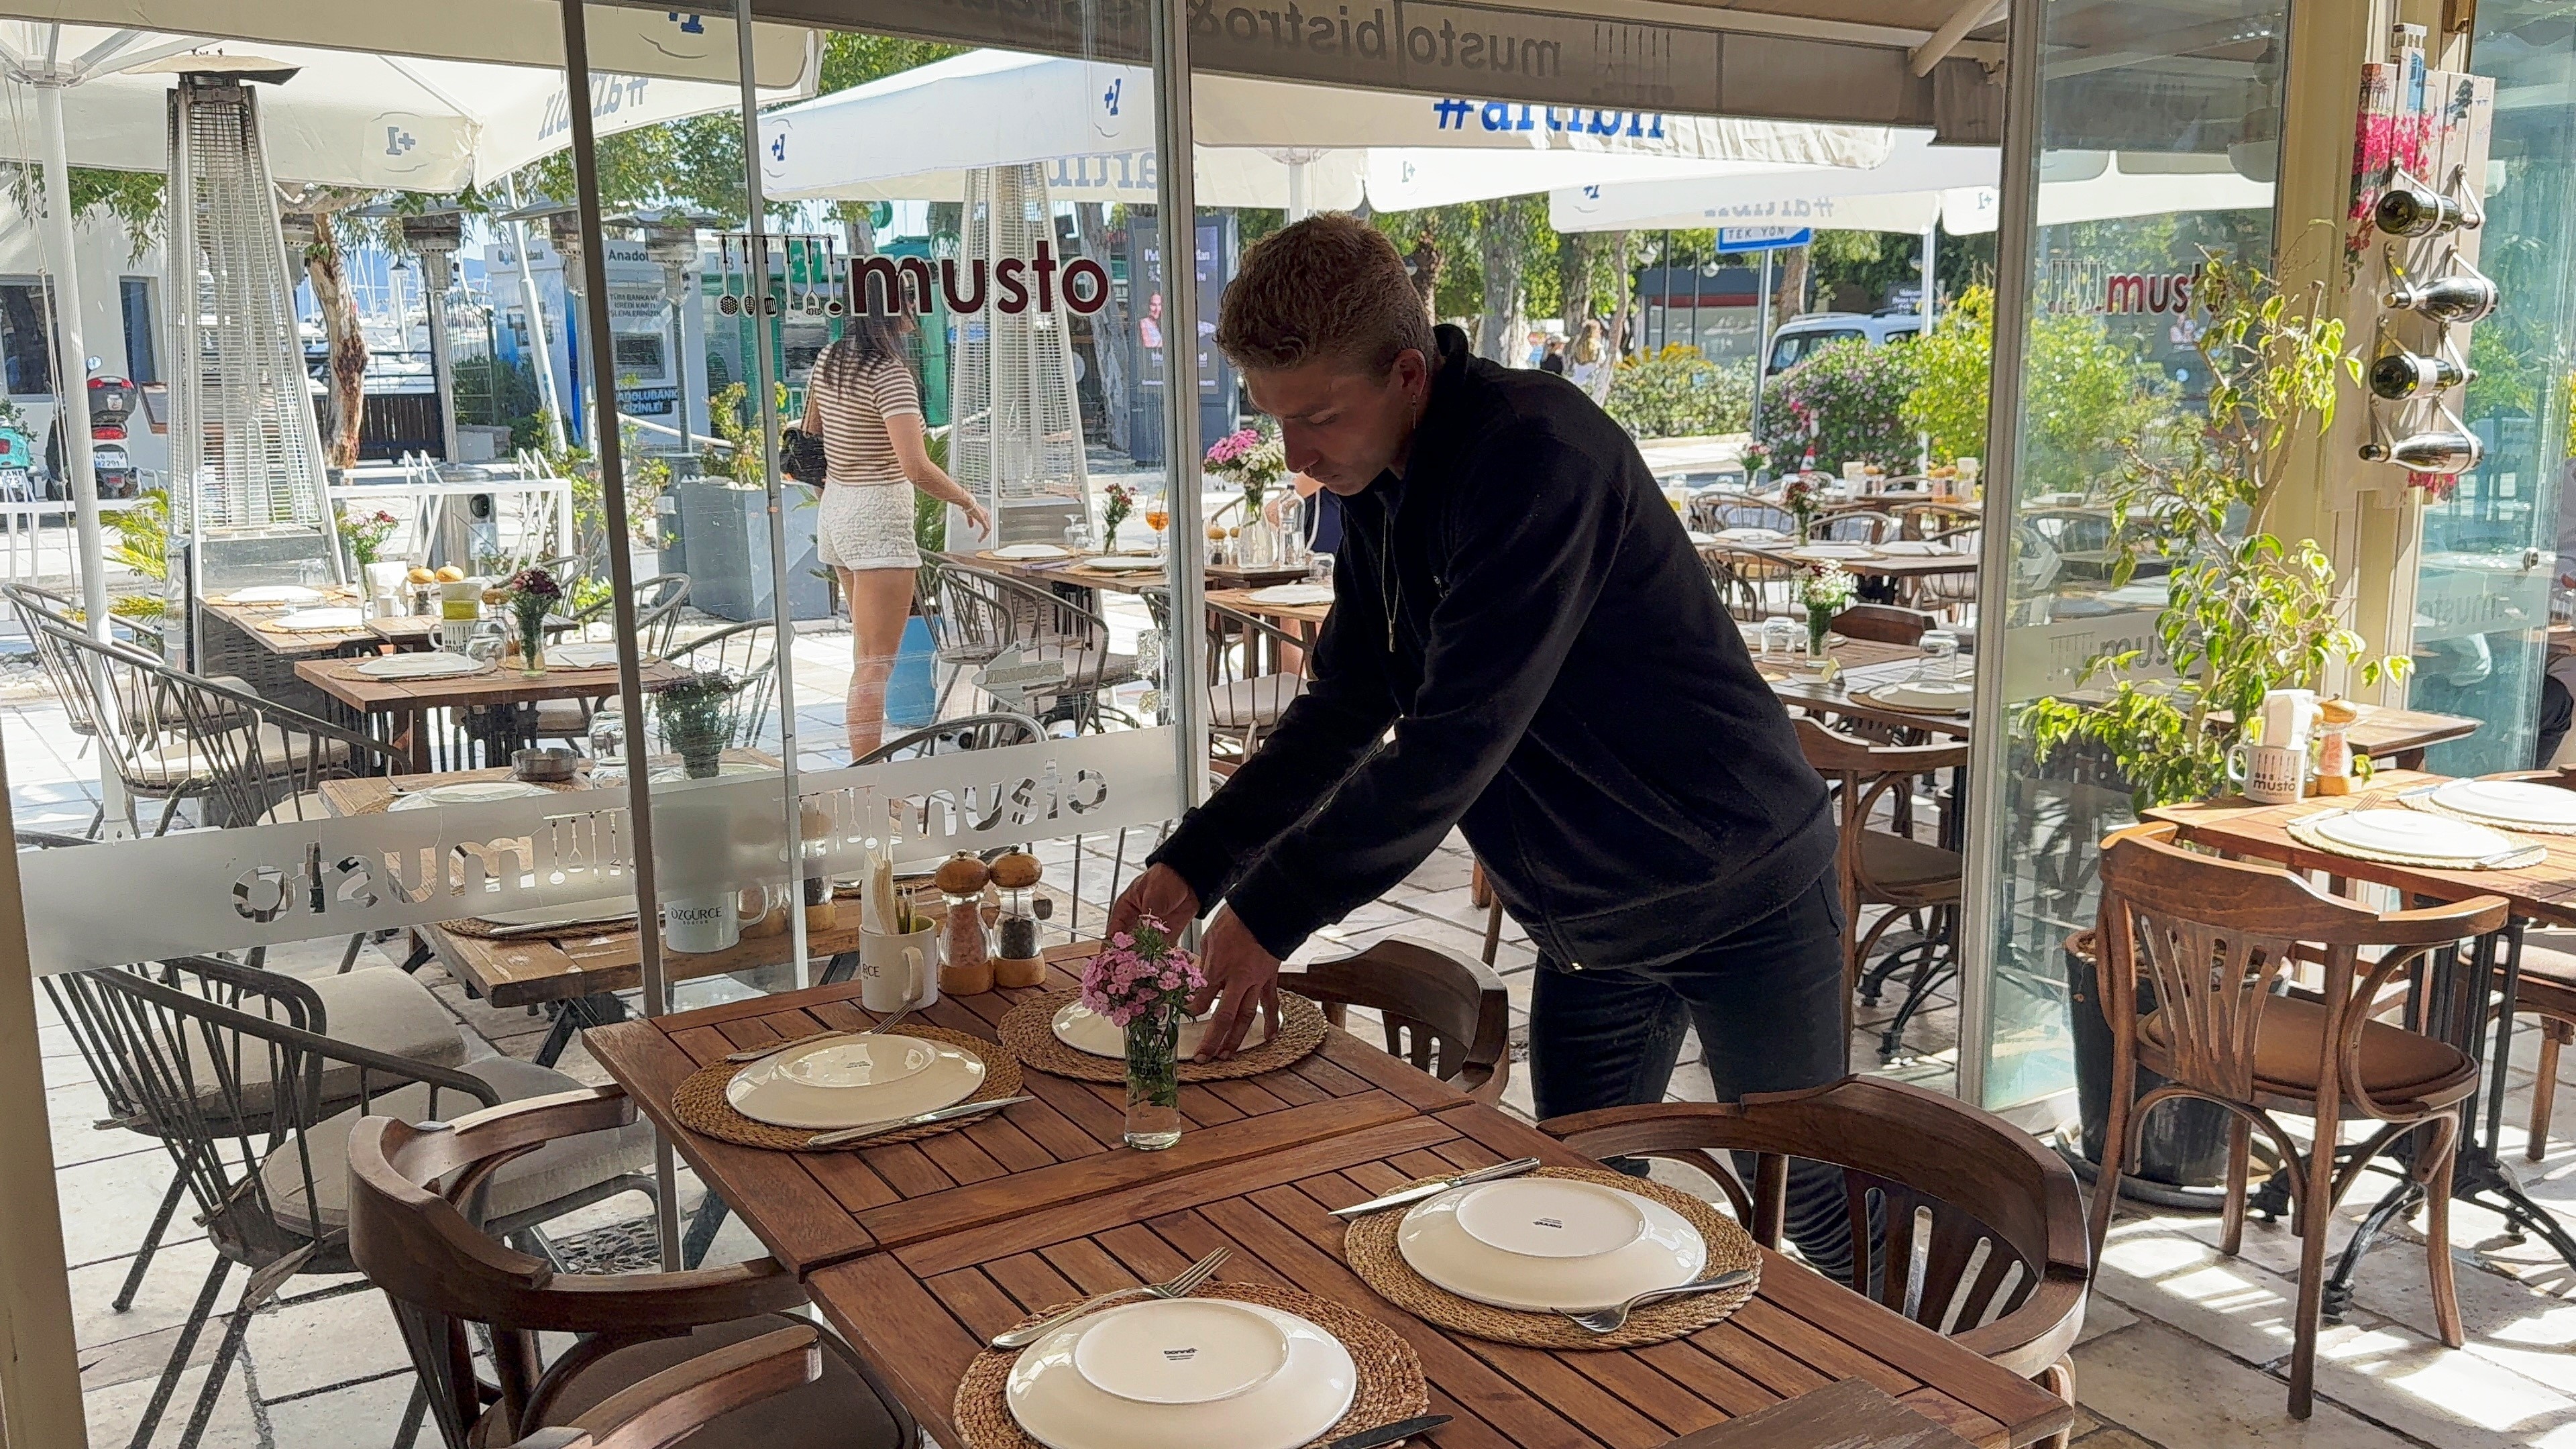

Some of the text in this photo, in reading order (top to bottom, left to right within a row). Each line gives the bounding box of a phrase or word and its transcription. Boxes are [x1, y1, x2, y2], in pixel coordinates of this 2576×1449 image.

[851, 240, 1109, 314] musto
[888, 759, 1108, 844] musto
[2253, 780, 2296, 792] musto
